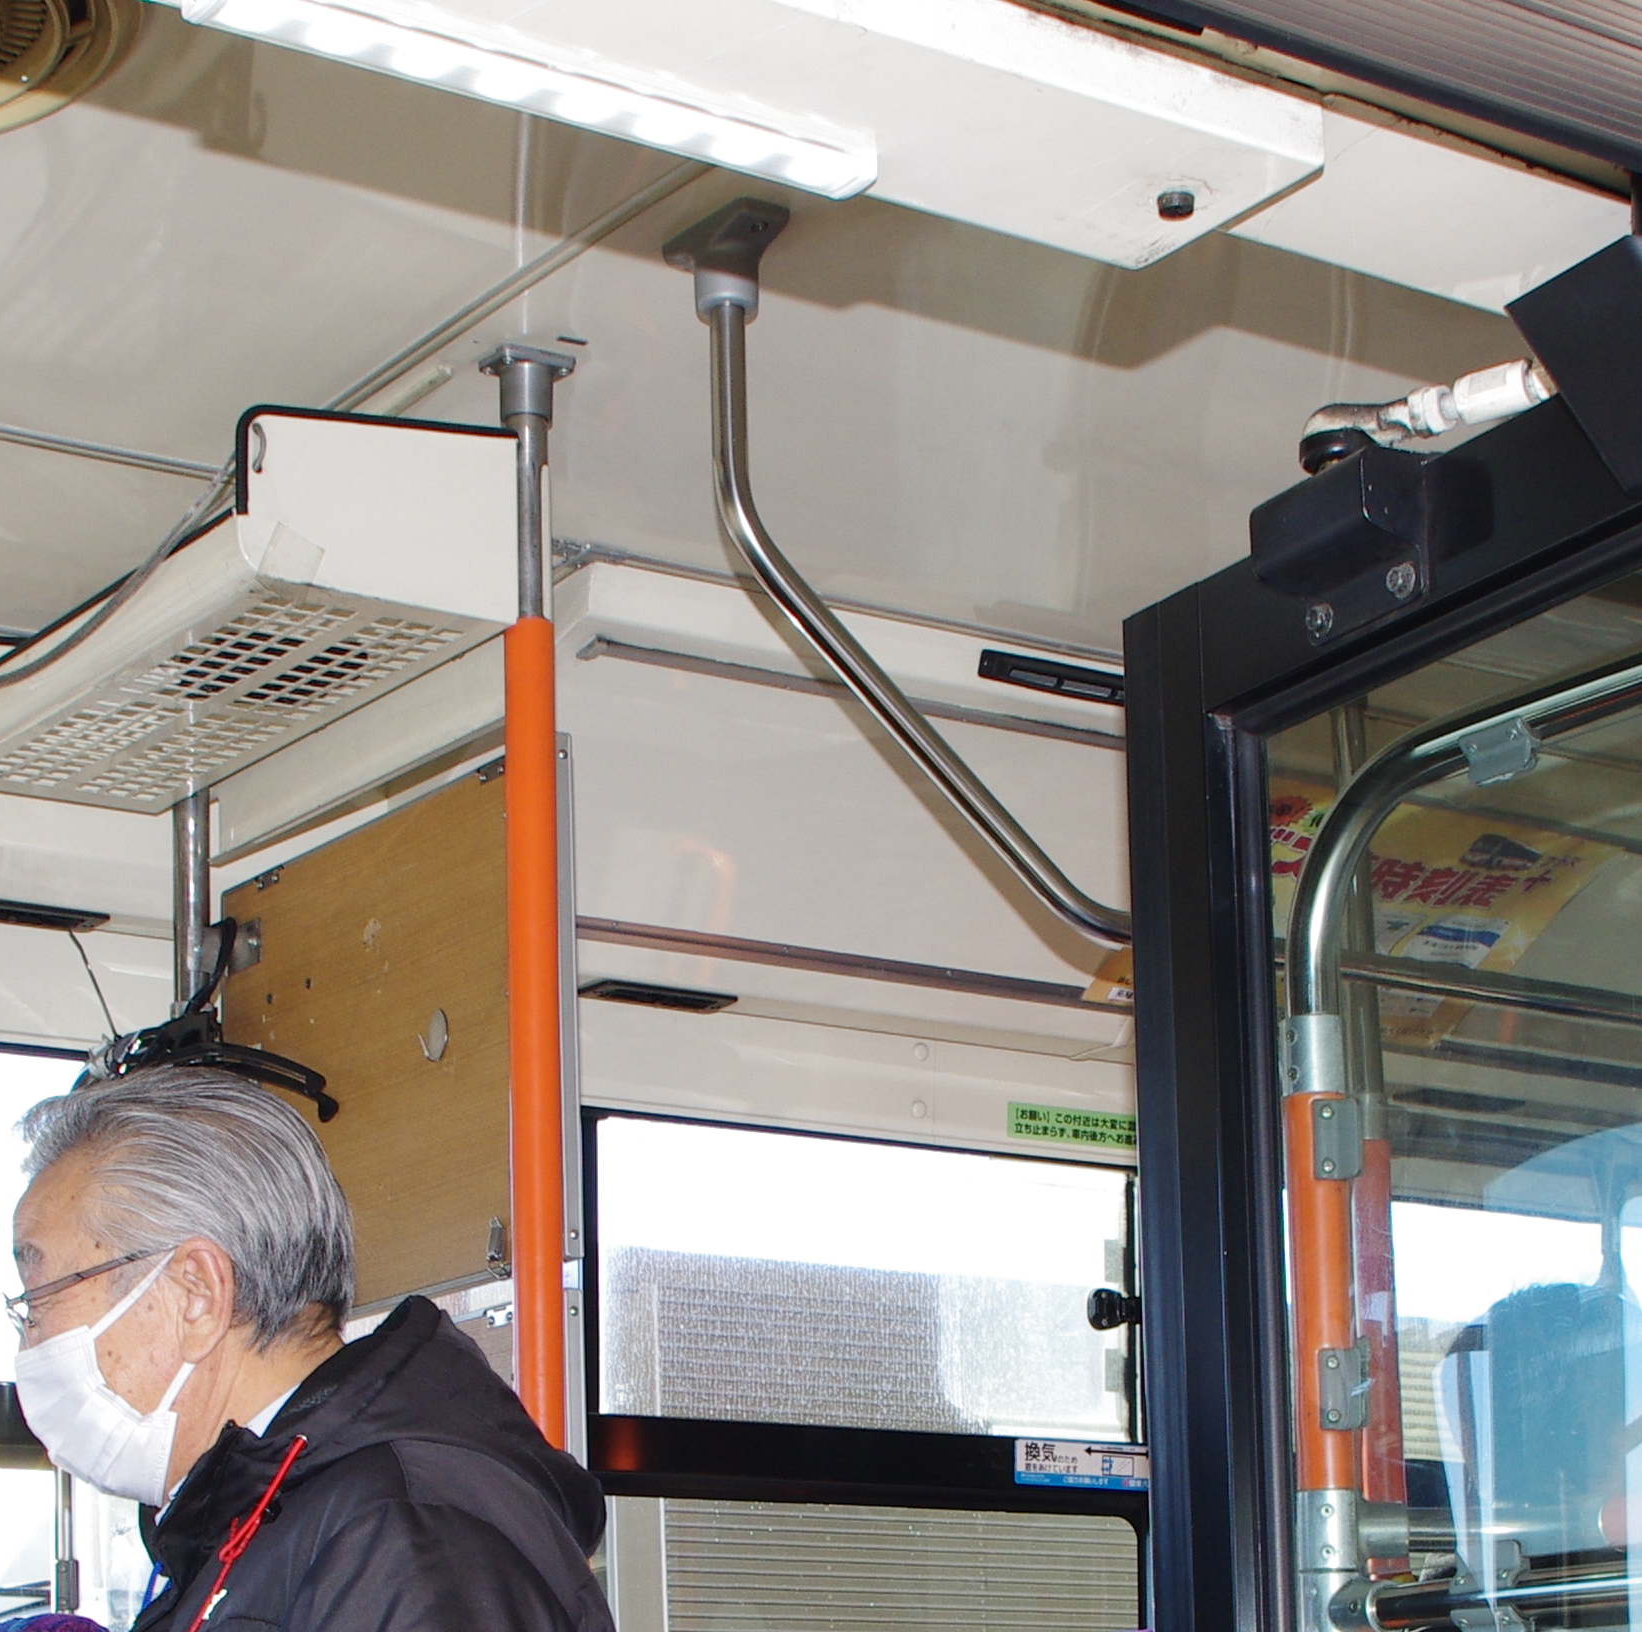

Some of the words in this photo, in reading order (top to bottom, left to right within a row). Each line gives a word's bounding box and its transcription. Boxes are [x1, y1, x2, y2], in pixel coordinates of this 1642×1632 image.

[1014, 1122, 1137, 1145] 立ち止まらず、車内後方へお進
